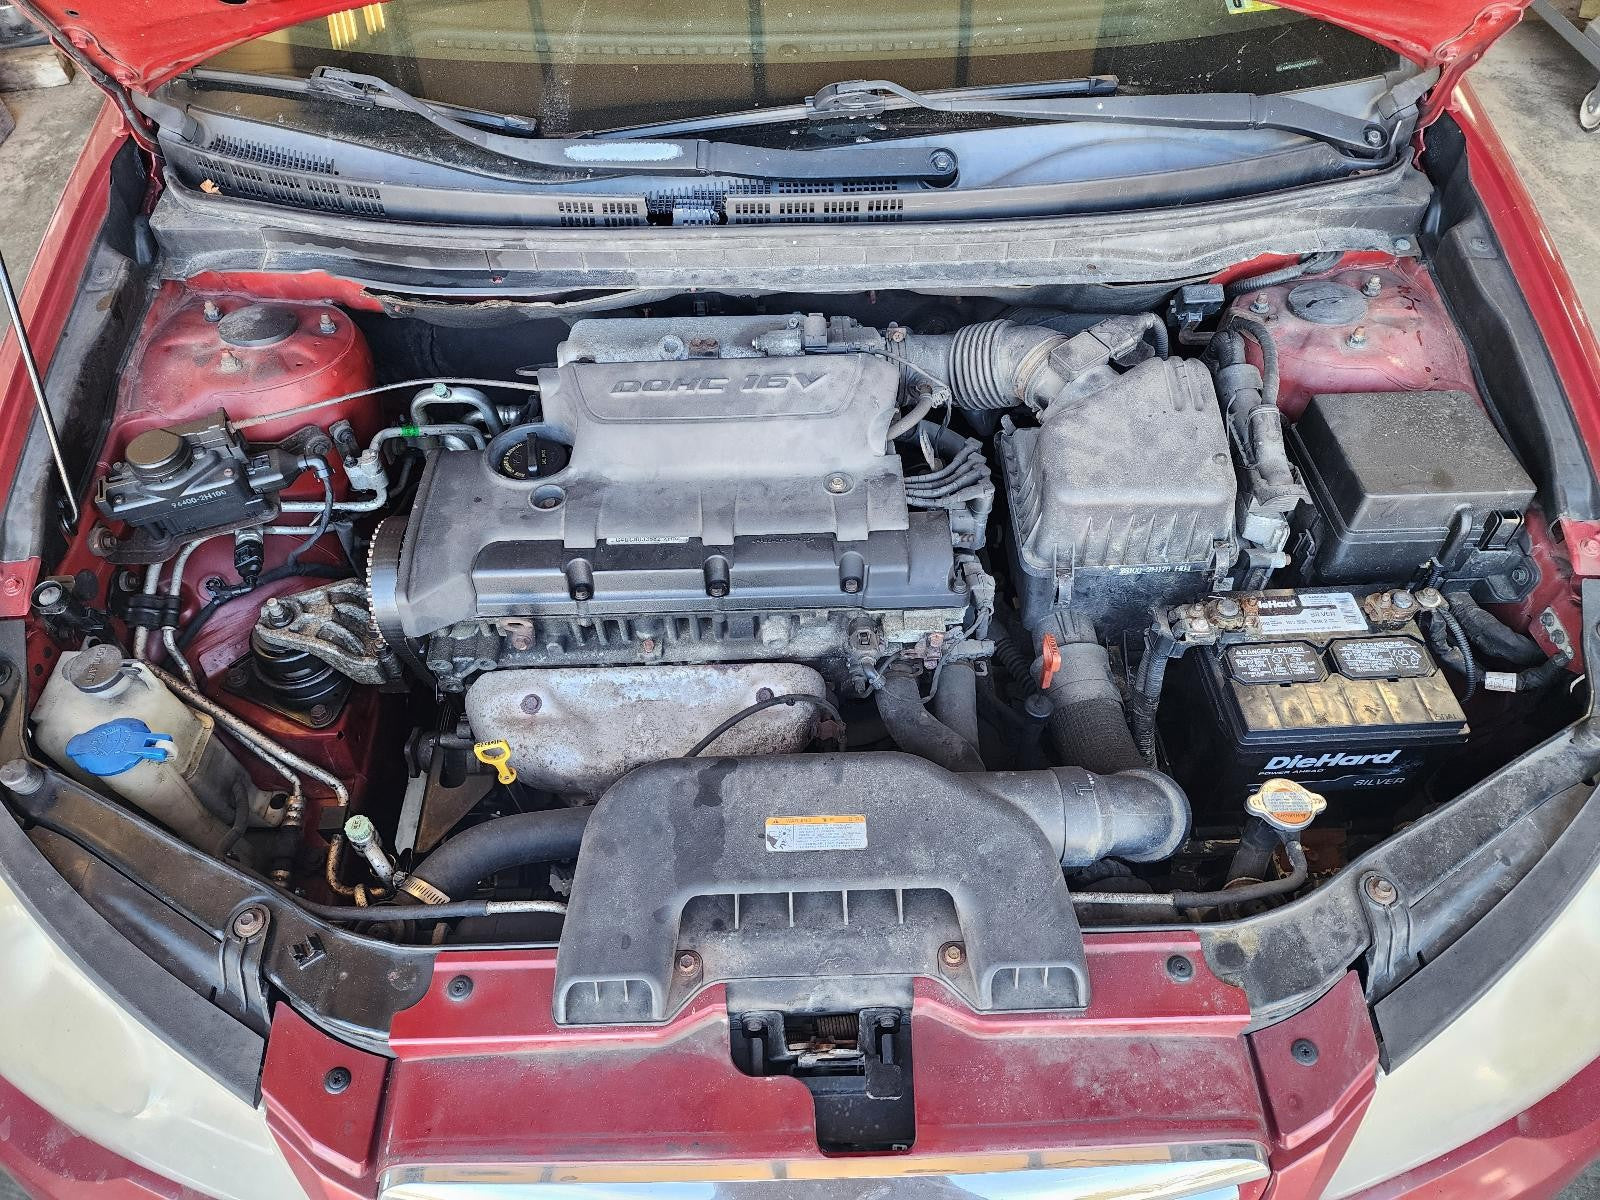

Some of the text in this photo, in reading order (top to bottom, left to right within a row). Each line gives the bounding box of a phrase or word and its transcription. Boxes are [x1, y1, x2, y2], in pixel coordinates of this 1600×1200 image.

[609, 373, 829, 396] DOHC 16V
[171, 489, 227, 508] 96400-2H100
[1257, 599, 1298, 608] ieHard
[1264, 749, 1402, 770] DieHard
[1353, 777, 1406, 786] SILVER
